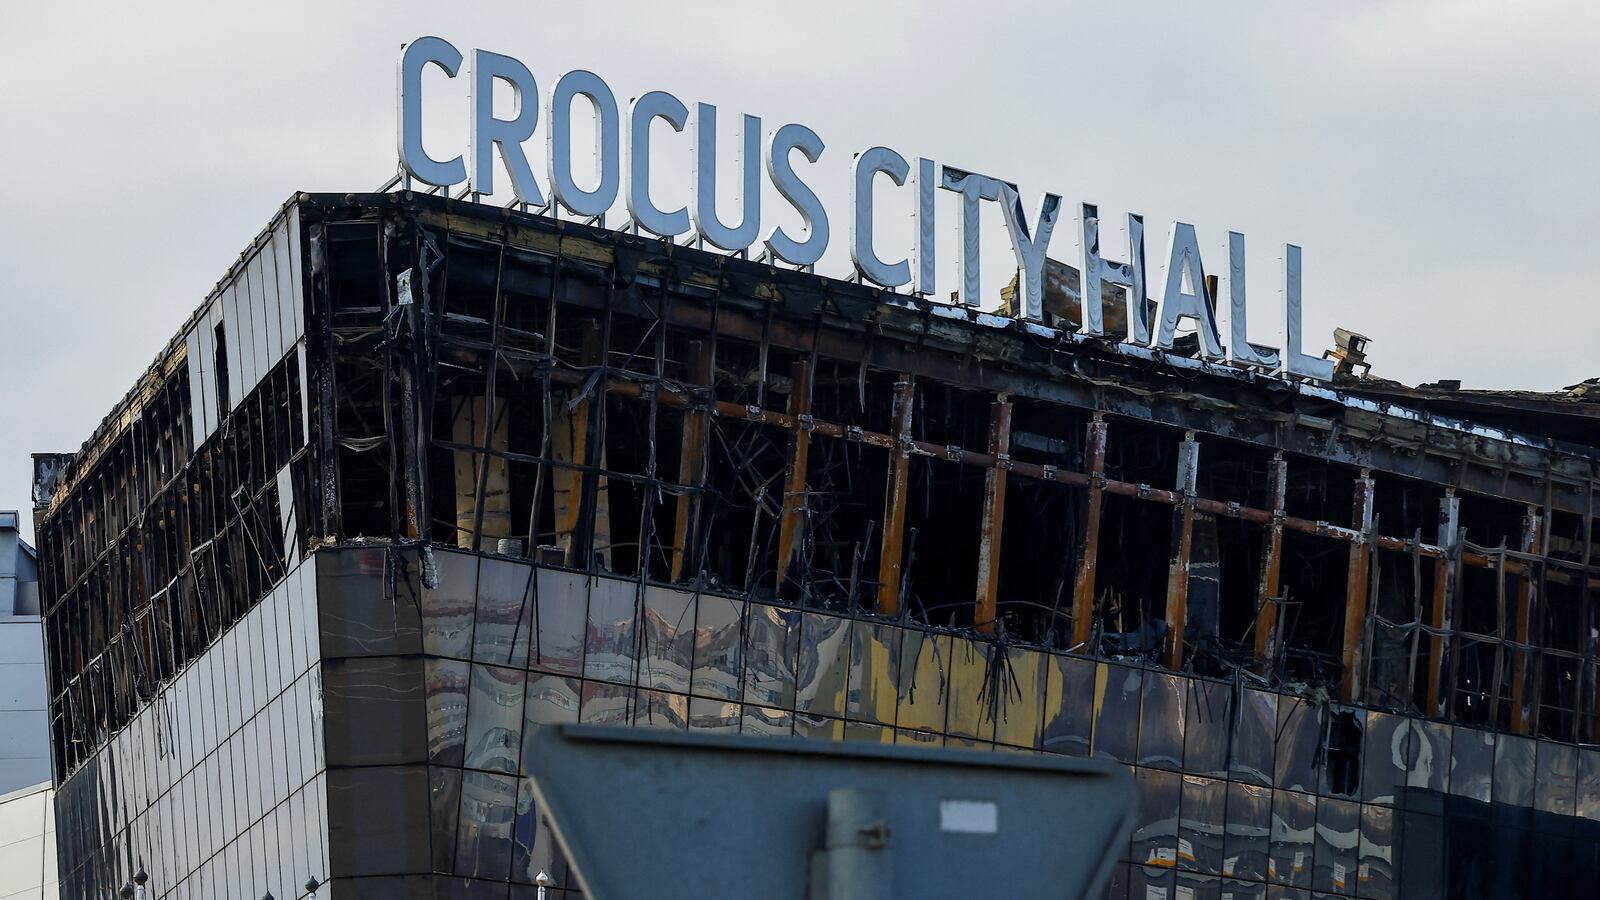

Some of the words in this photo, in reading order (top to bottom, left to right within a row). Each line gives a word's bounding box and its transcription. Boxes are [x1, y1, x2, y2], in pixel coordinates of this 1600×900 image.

[398, 36, 829, 265] CROCUS
[850, 146, 1062, 322] CITY
[1077, 202, 1334, 381] HALL
